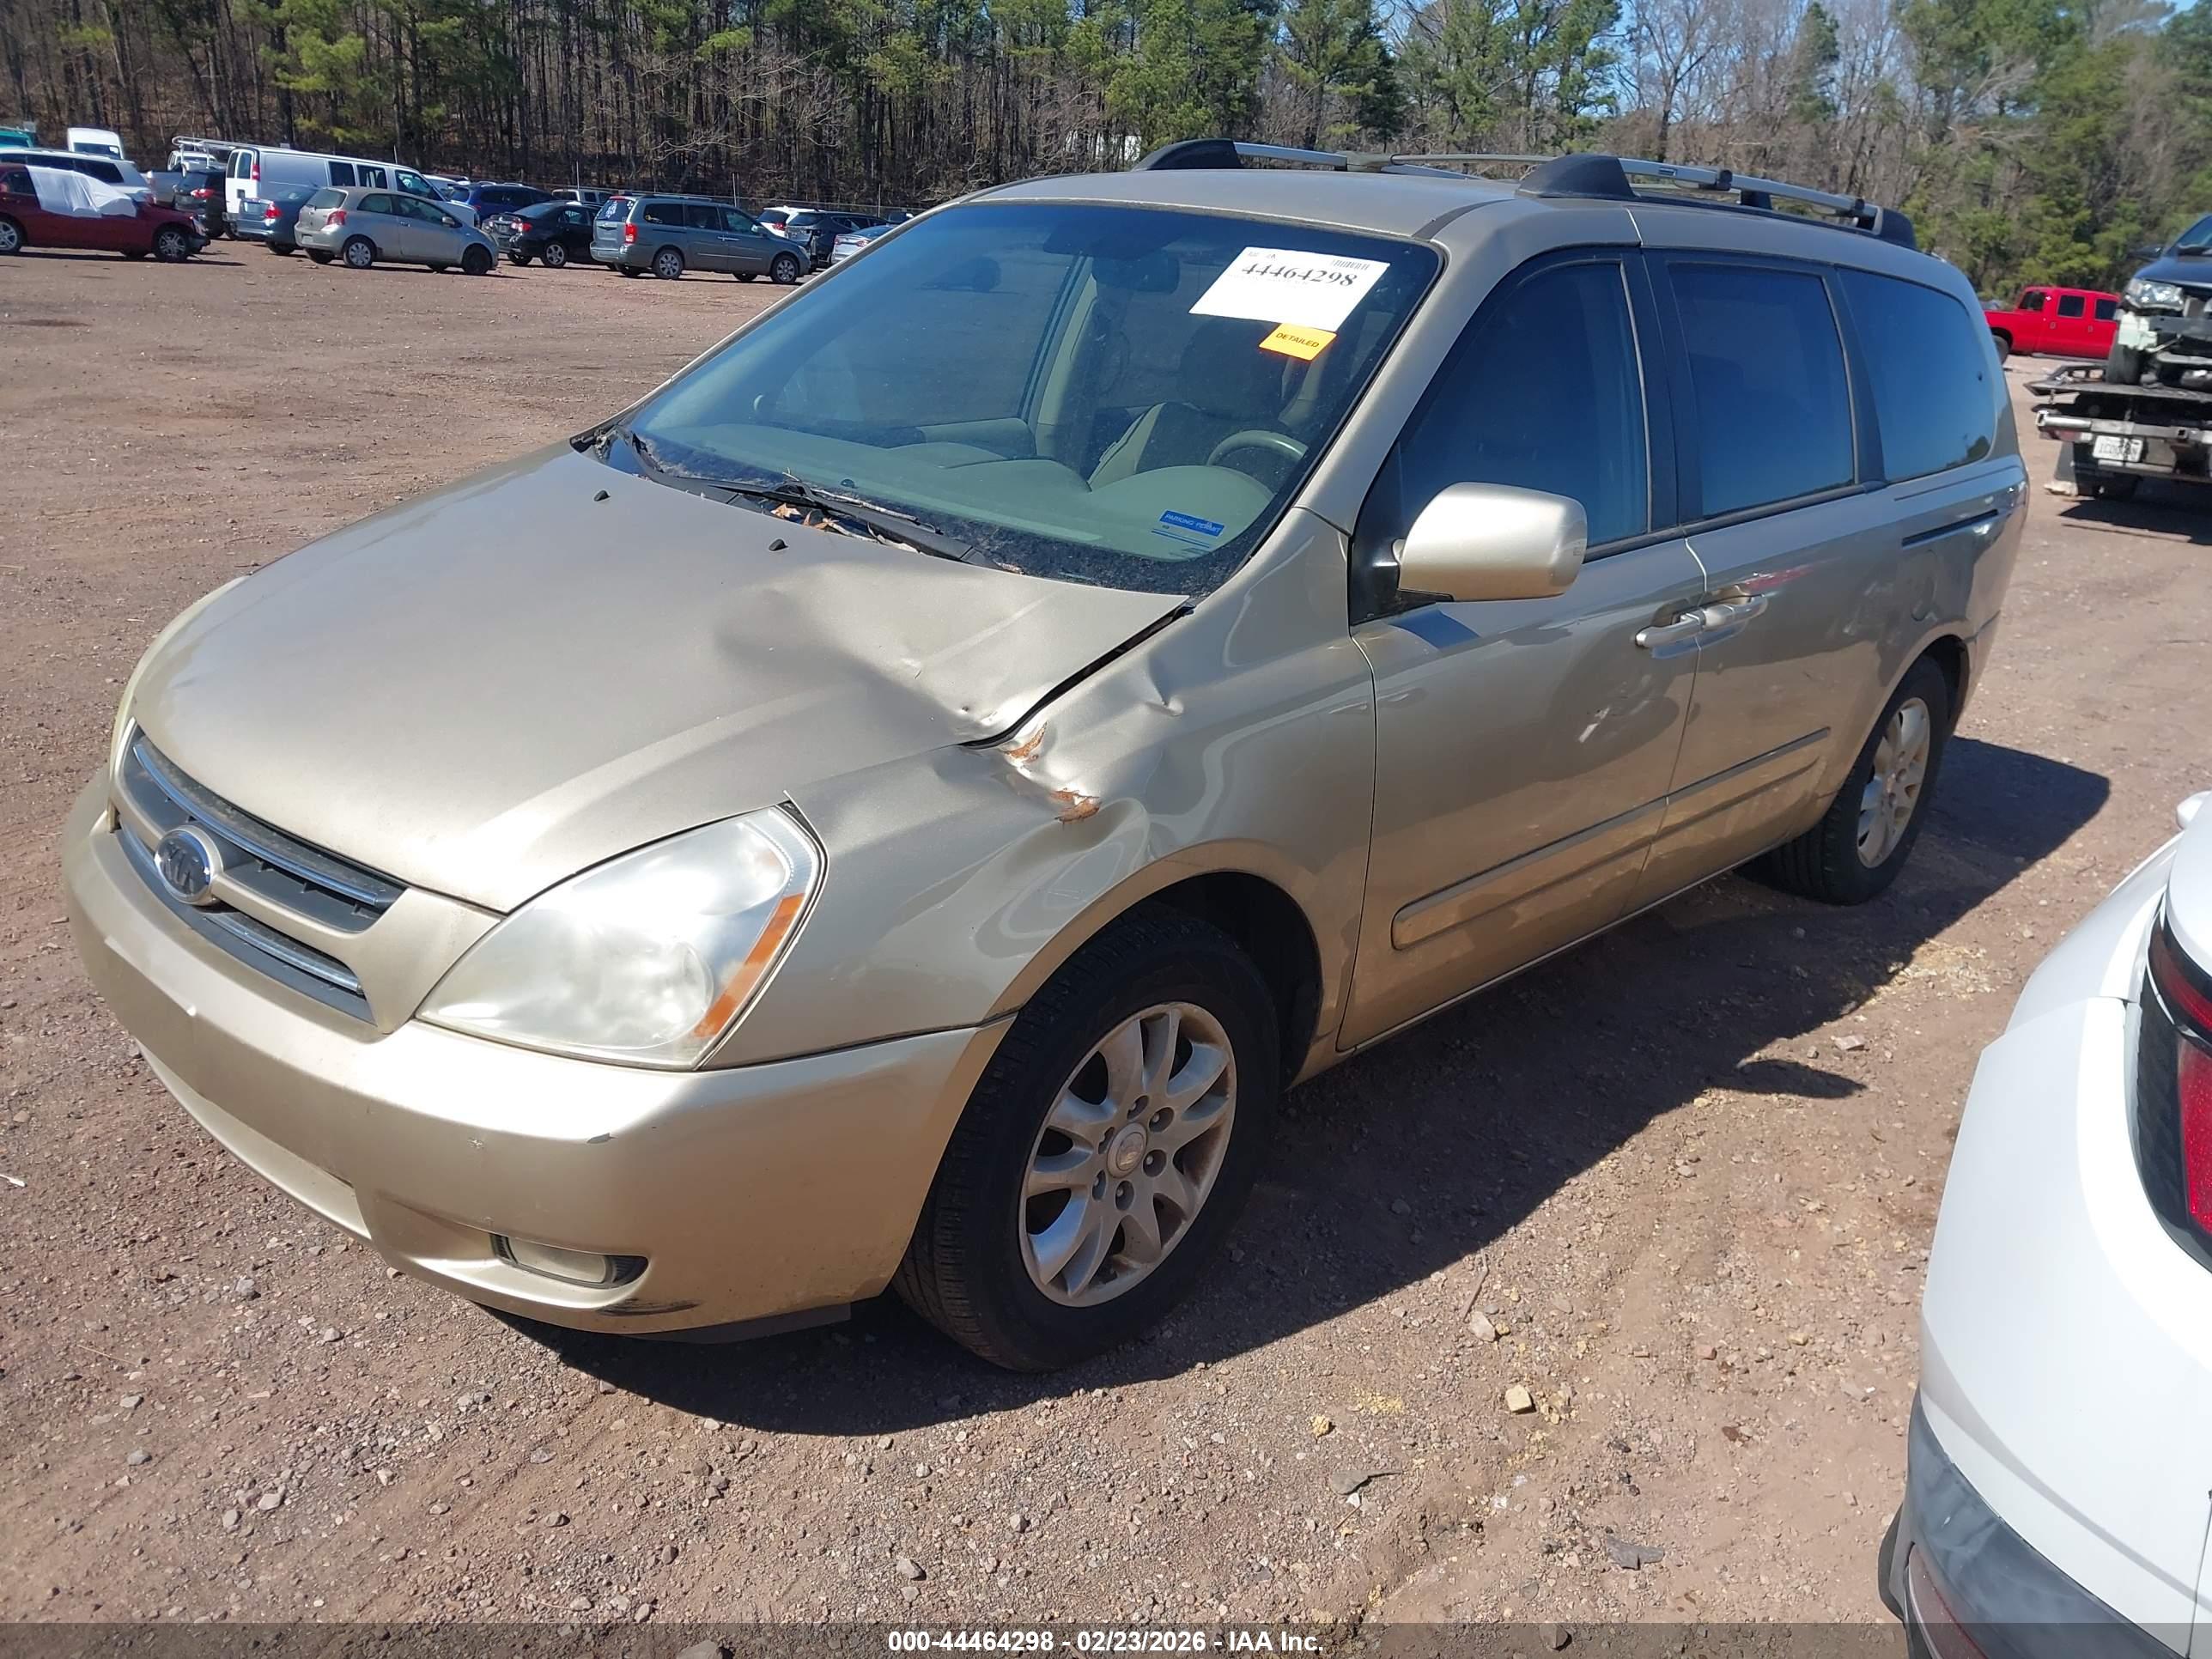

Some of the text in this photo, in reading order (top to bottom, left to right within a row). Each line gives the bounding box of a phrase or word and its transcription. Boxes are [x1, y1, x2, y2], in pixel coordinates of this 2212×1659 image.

[1242, 263, 1358, 287] 44464298
[1276, 332, 1320, 348] DETAILED
[1164, 514, 1194, 526] PARKING
